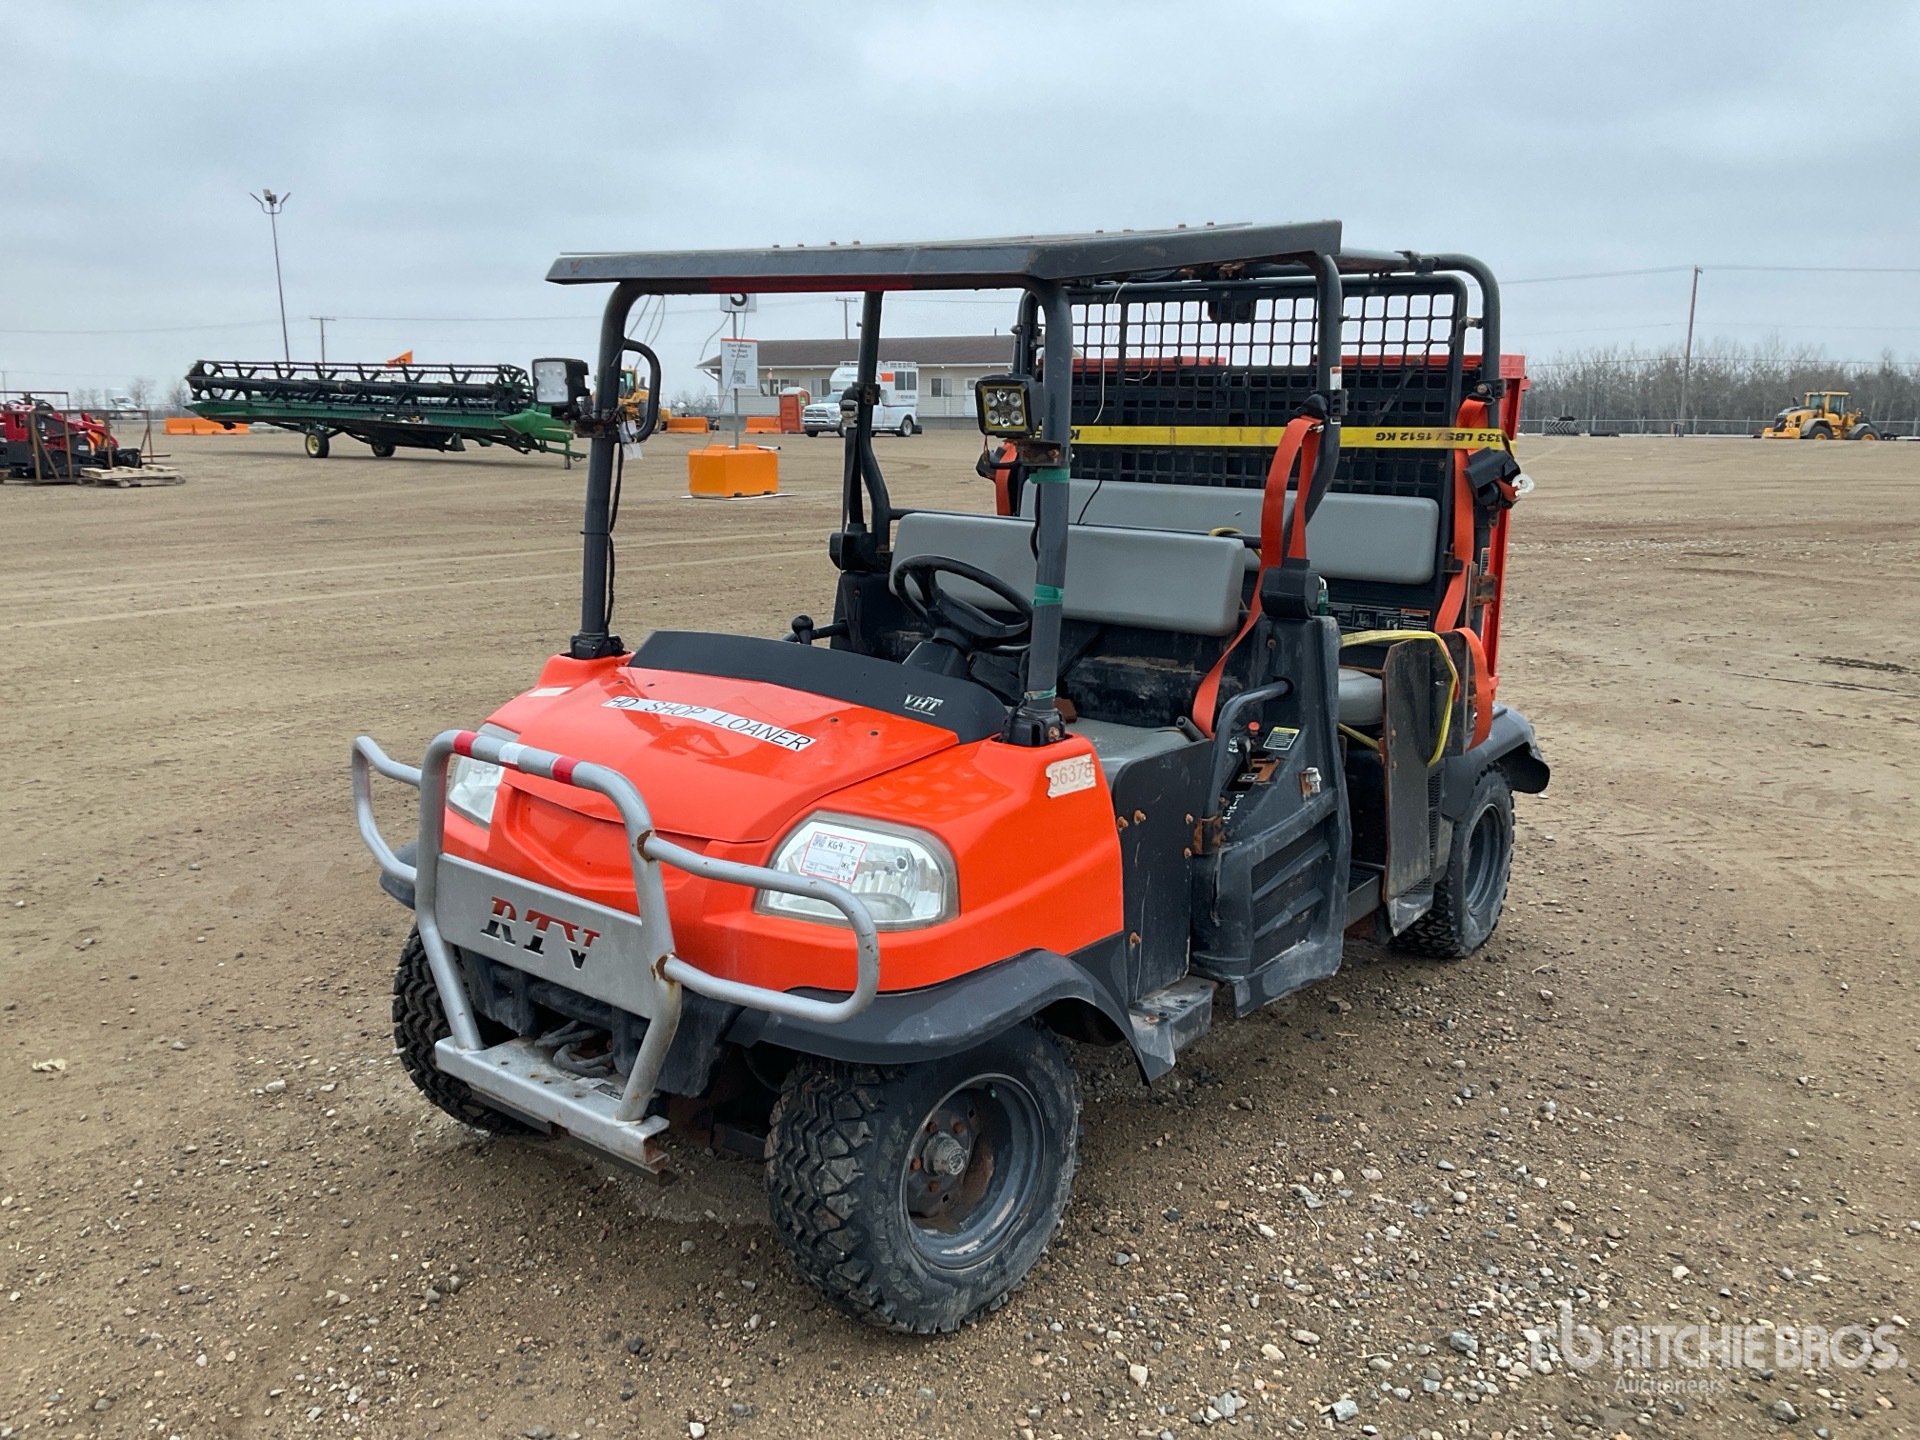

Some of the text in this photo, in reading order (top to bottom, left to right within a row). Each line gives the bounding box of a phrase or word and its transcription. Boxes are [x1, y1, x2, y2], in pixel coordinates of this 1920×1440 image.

[1375, 432, 1396, 441] KG
[1400, 431, 1432, 441] 1512
[1445, 432, 1473, 442] LBS
[903, 693, 944, 712] VHT
[644, 701, 707, 716] SHOP
[711, 713, 812, 750] LOANER
[480, 895, 601, 971] RTV
